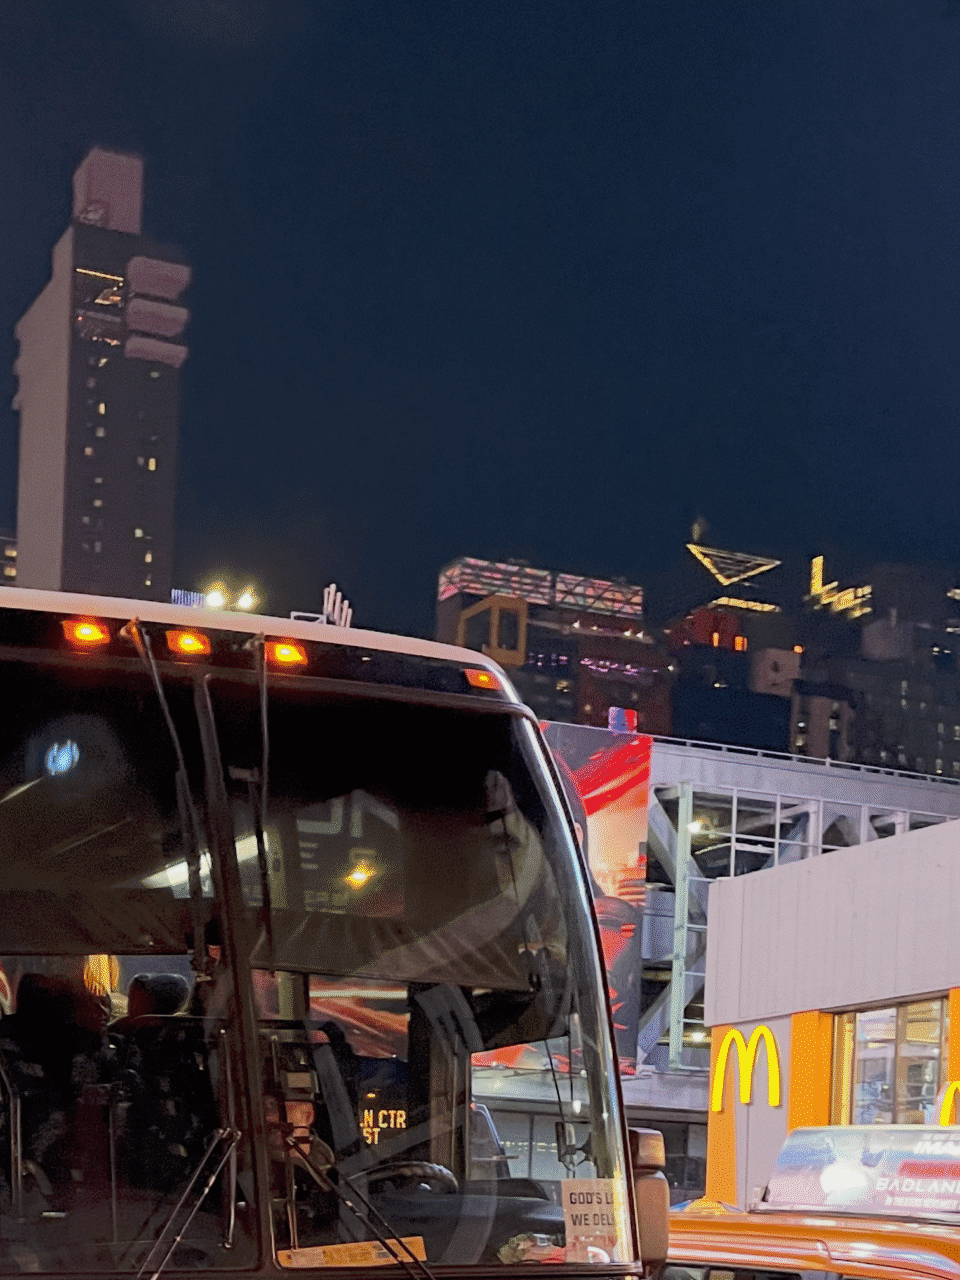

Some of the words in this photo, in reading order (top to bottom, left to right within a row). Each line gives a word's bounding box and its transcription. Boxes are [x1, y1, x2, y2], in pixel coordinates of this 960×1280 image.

[378, 1109, 407, 1129] CTR
[362, 1127, 381, 1145] ST
[569, 1191, 603, 1205] GOD'S
[570, 1213, 590, 1226] WE
